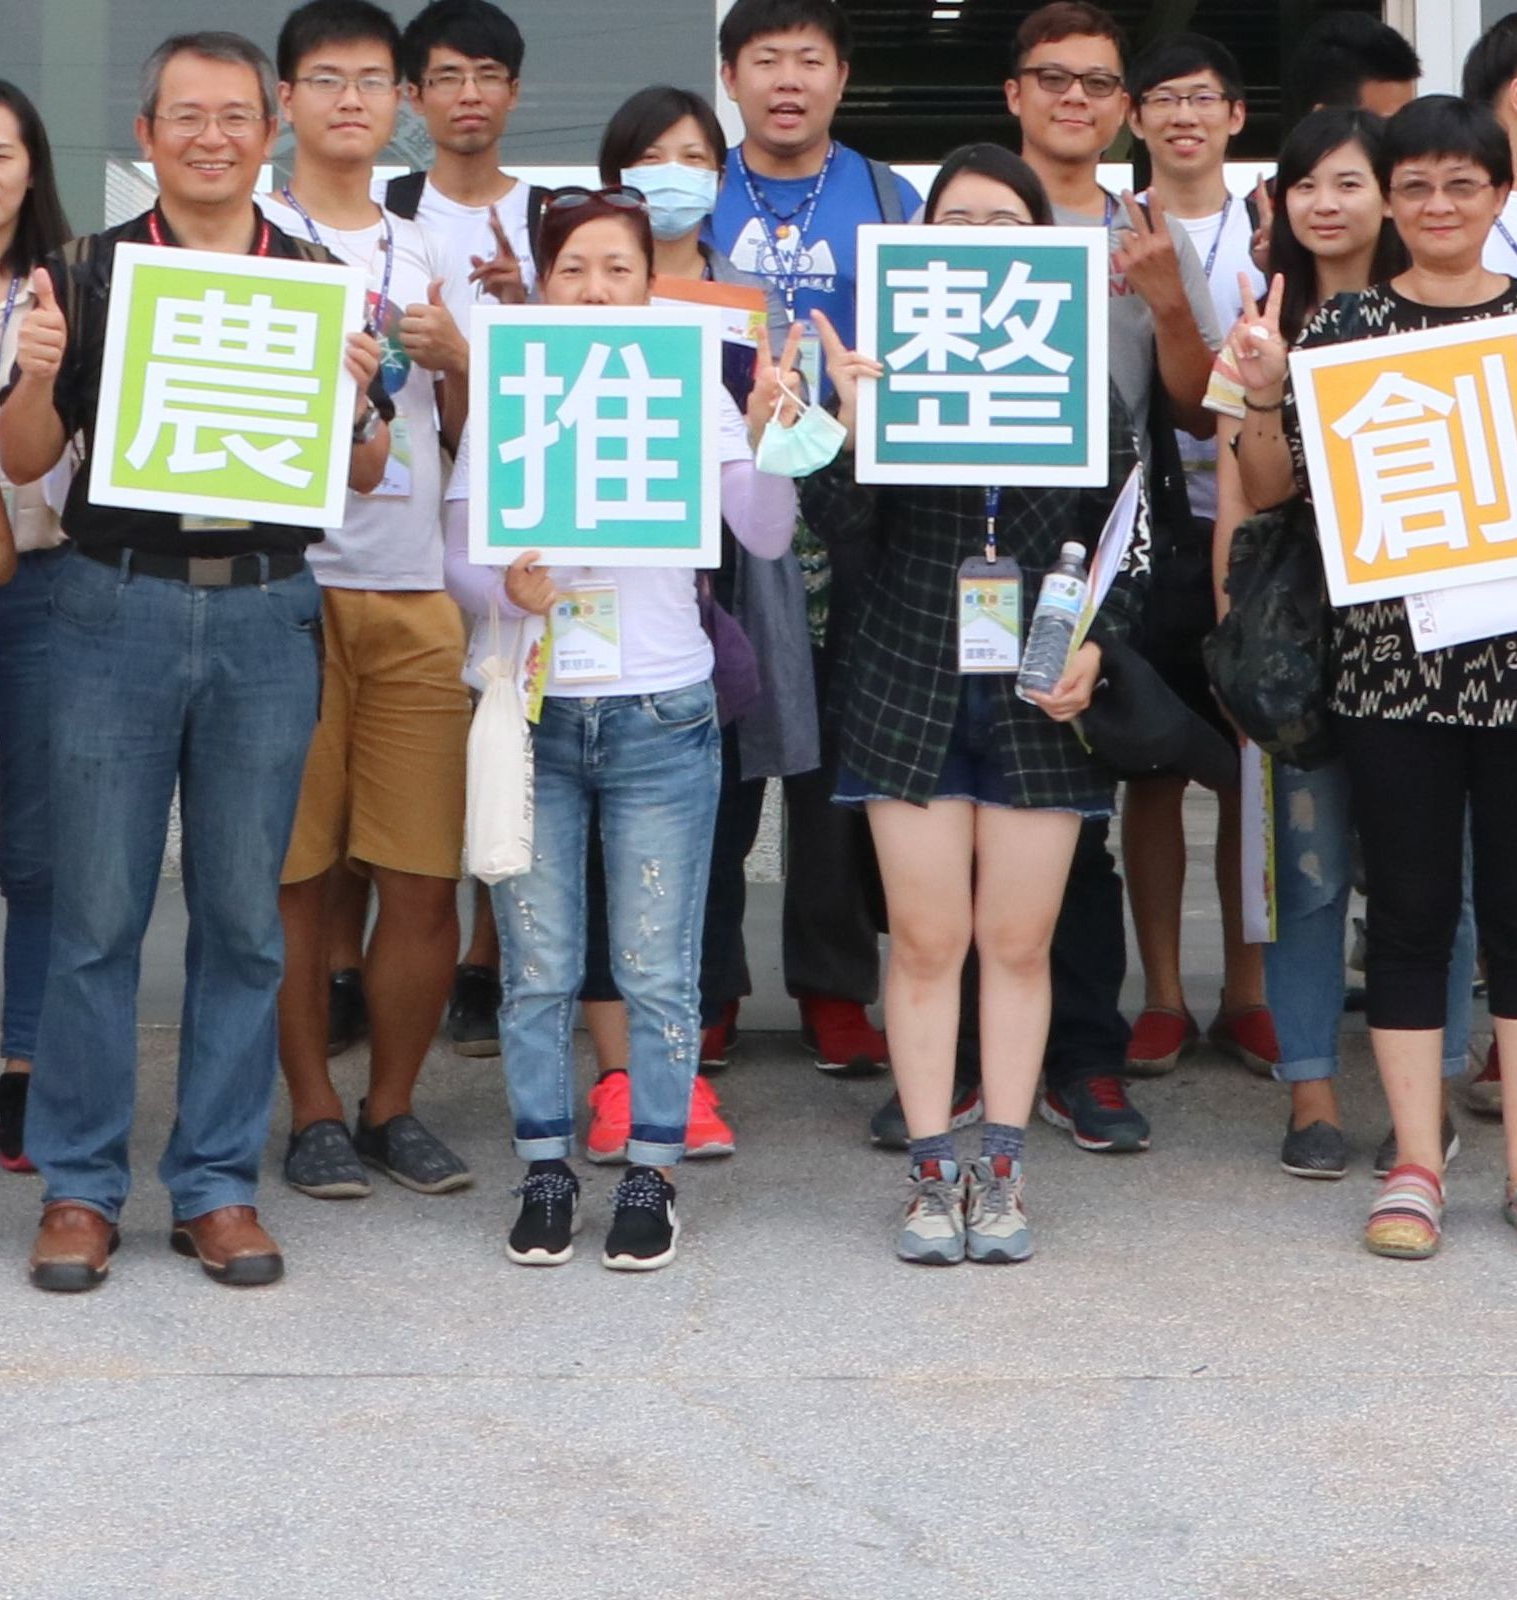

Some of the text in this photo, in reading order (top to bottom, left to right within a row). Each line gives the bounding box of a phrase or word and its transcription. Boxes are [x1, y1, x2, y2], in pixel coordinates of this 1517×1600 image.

[124, 288, 321, 489] 農
[499, 342, 686, 530] 推
[885, 260, 1074, 445] 整
